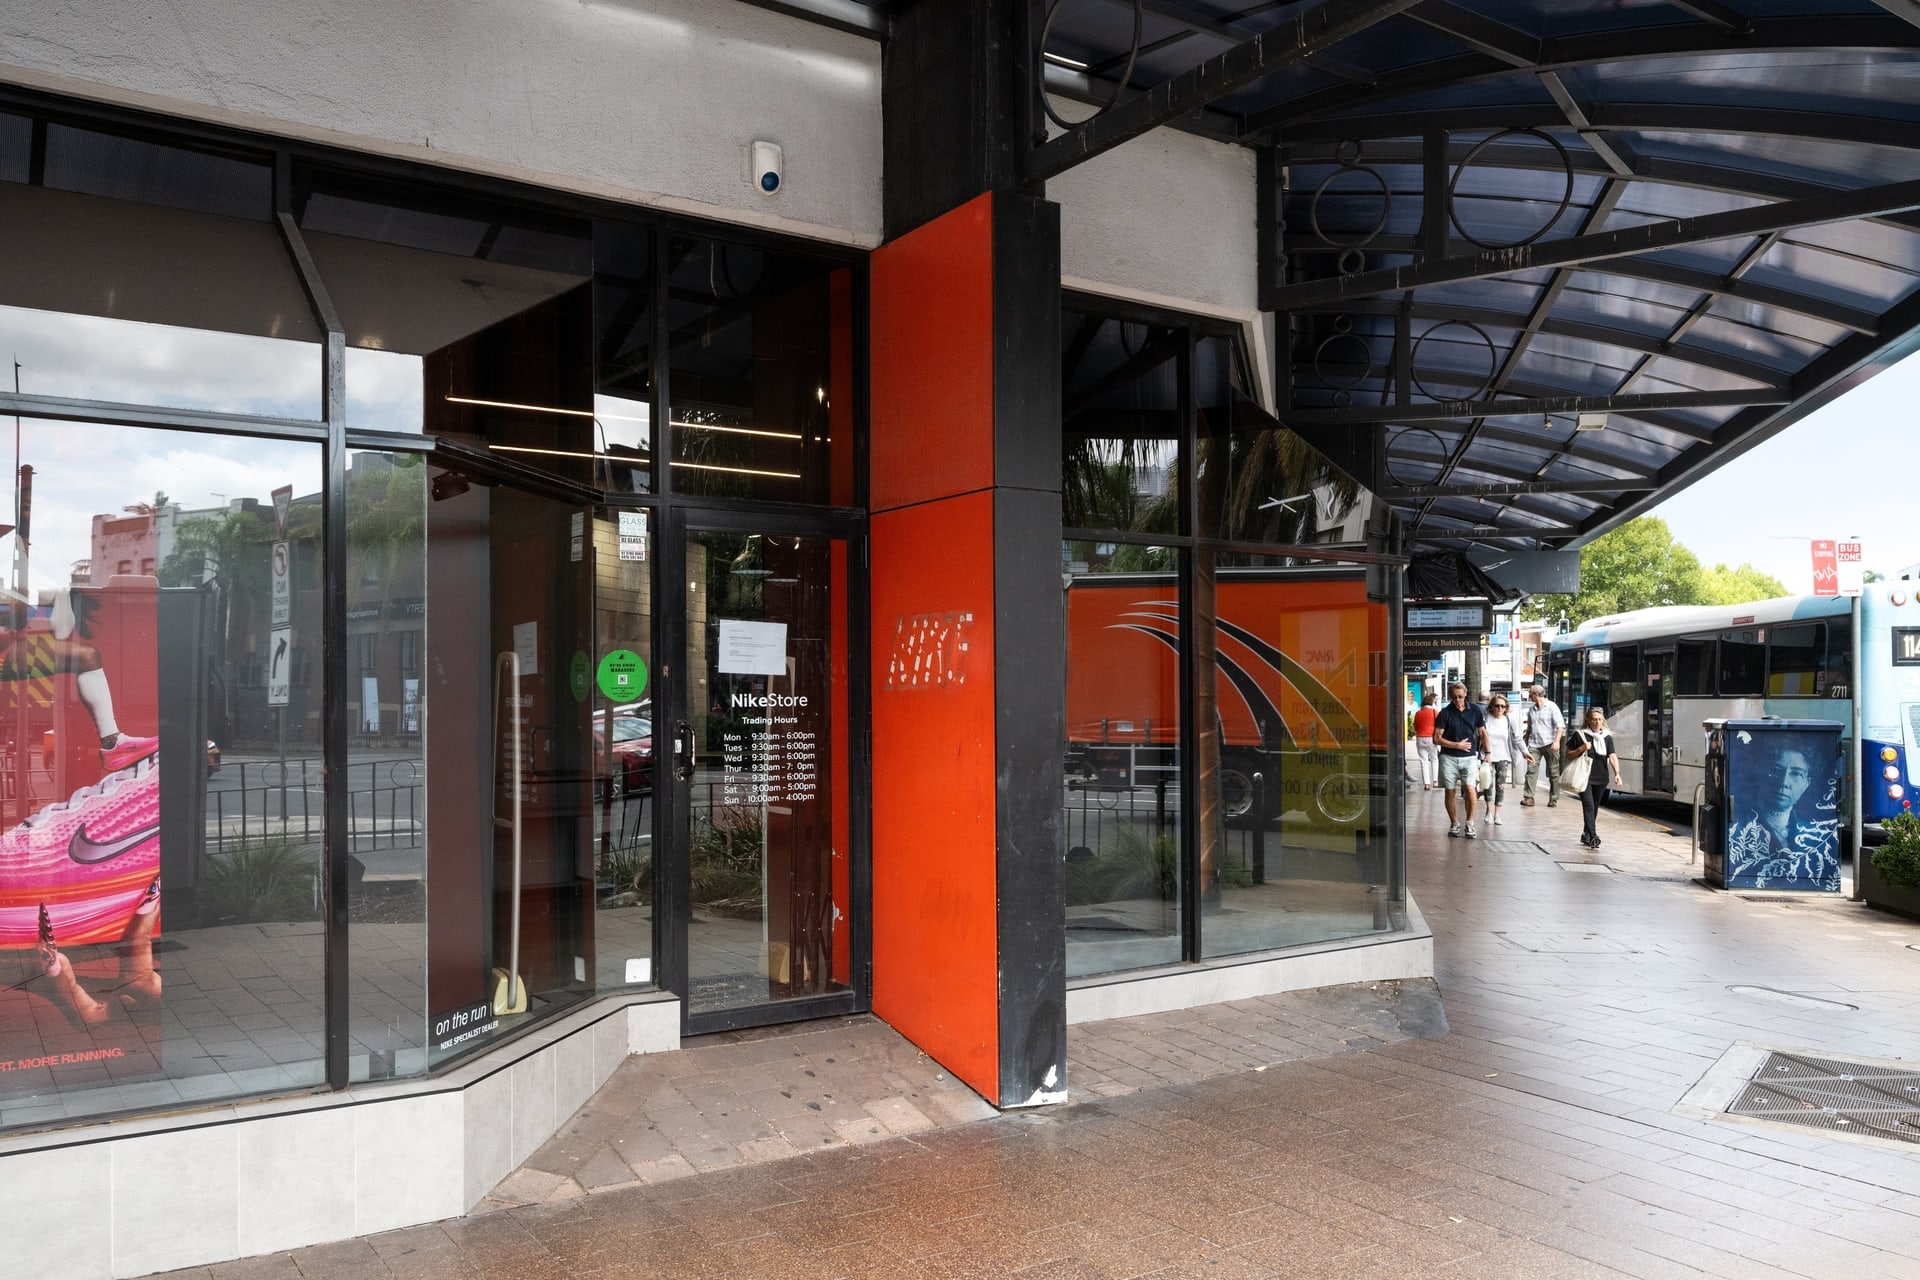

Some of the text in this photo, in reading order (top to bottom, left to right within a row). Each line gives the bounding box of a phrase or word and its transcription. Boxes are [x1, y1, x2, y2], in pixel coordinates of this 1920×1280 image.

[1832, 686, 1847, 698] 2711
[731, 693, 808, 707] NikeStore
[742, 716, 772, 725] Trading
[786, 732, 815, 740] 6:00pm
[786, 742, 815, 750] 6:00pm
[787, 752, 815, 761] 6:00pm
[787, 773, 815, 781] 6:00pm
[752, 784, 780, 792] 9:00am
[787, 783, 816, 791] 5:00pm
[785, 793, 814, 801] 4:00pm
[436, 1005, 486, 1035] on the run
[440, 1020, 499, 1050] NIKE SPECIALIST DEALER
[18, 1055, 59, 1069] MORE
[61, 1048, 124, 1064] RUNNING.
